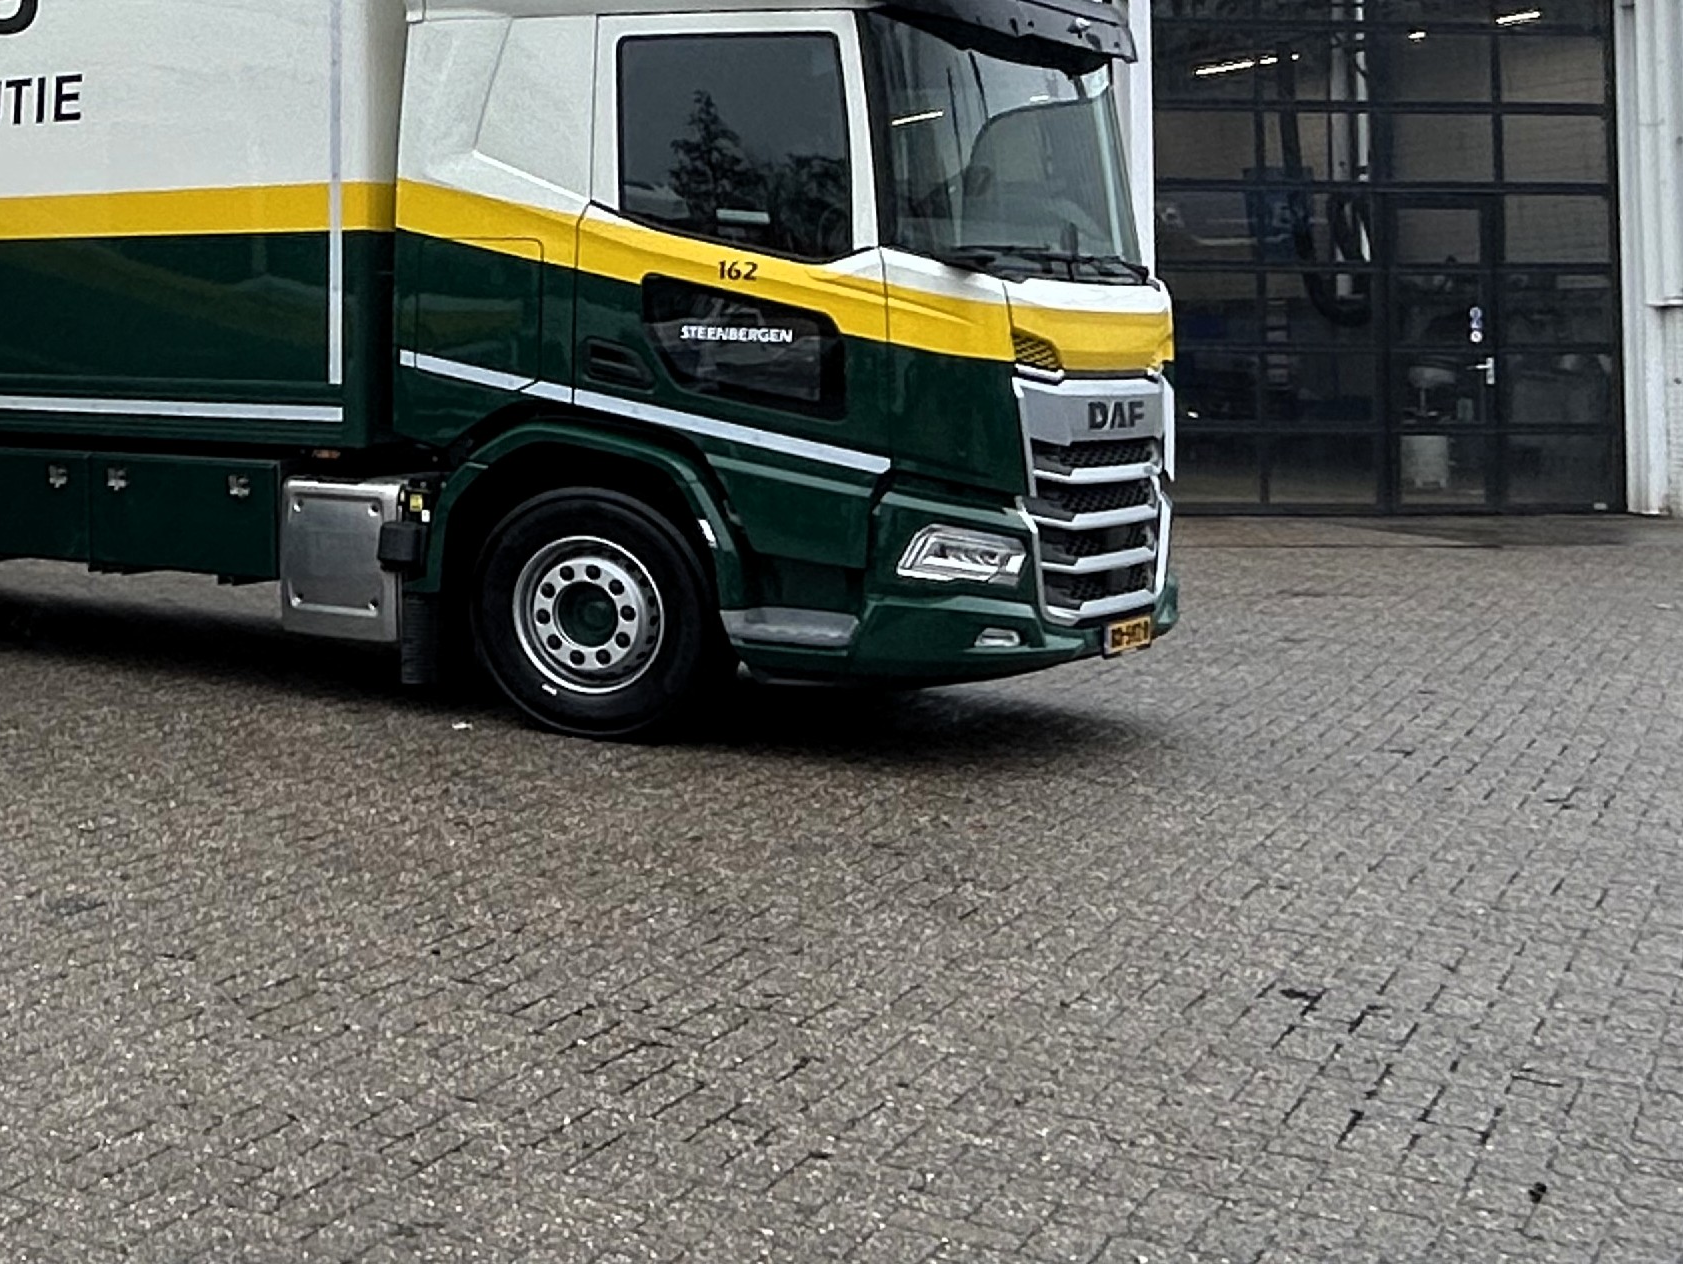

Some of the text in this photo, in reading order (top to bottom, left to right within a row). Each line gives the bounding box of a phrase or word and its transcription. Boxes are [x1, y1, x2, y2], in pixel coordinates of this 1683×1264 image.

[718, 260, 758, 281] 162
[680, 325, 793, 343] STEENBERGEN
[1088, 401, 1144, 430] DAF
